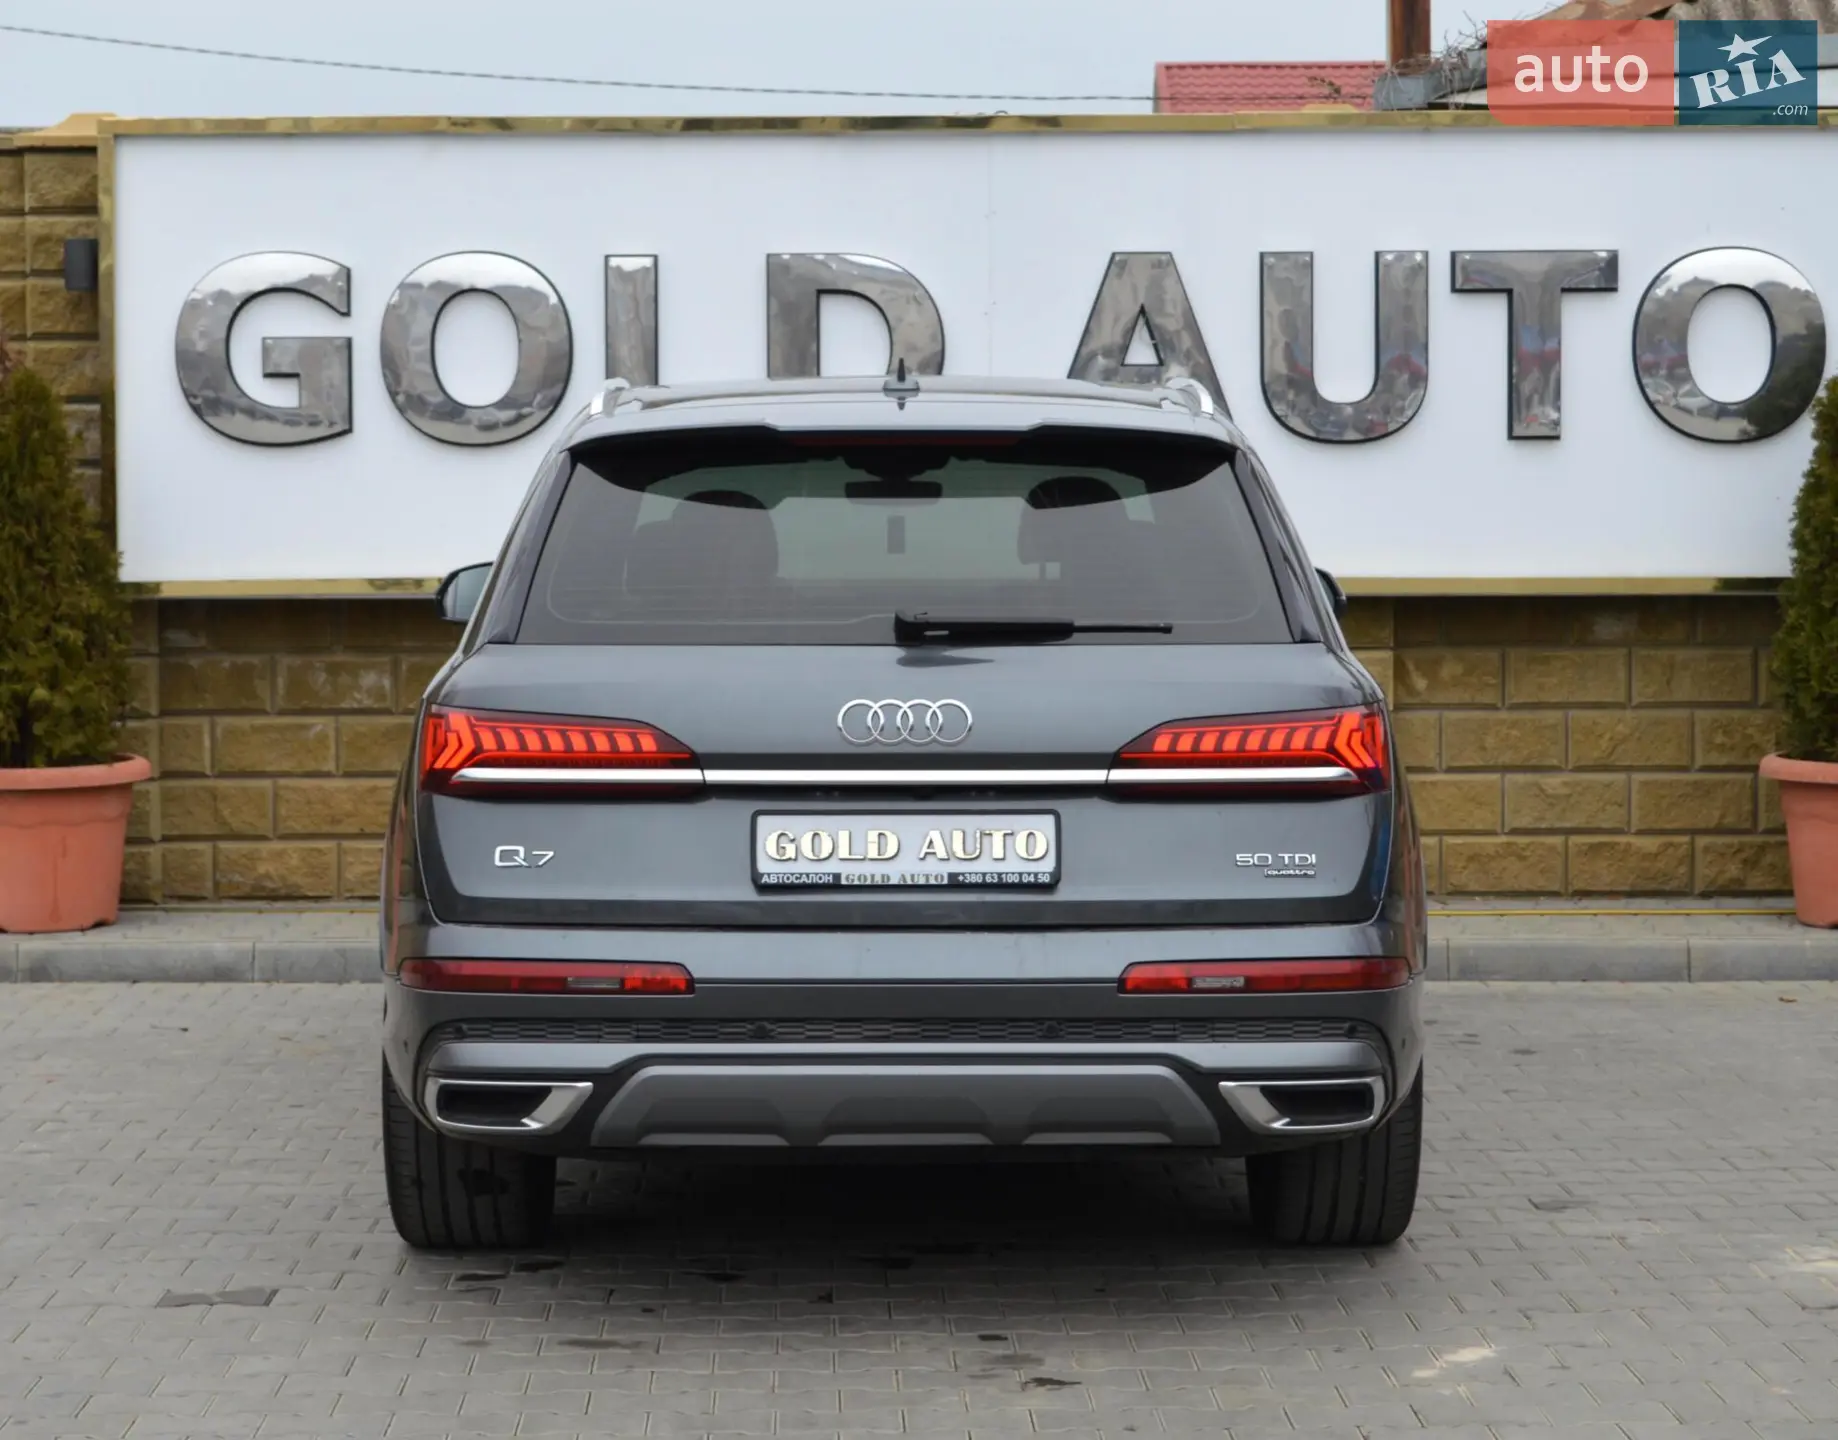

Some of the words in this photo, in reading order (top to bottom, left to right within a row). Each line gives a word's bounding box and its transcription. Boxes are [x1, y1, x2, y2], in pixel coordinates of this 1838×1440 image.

[1067, 246, 1827, 444] AUTO
[494, 845, 555, 868] Q7
[765, 829, 901, 861] GOLD
[917, 829, 1050, 861] AUTO
[1235, 853, 1273, 867] 50
[1277, 853, 1317, 867] TDI
[761, 873, 833, 884] АВТОСАЛОН
[844, 873, 891, 885] GOLD
[898, 873, 945, 885] AUTO
[957, 872, 983, 884] +380
[985, 872, 998, 884] 63
[1001, 872, 1019, 884] 100
[1021, 872, 1035, 884] 04
[1037, 872, 1050, 884] 50
